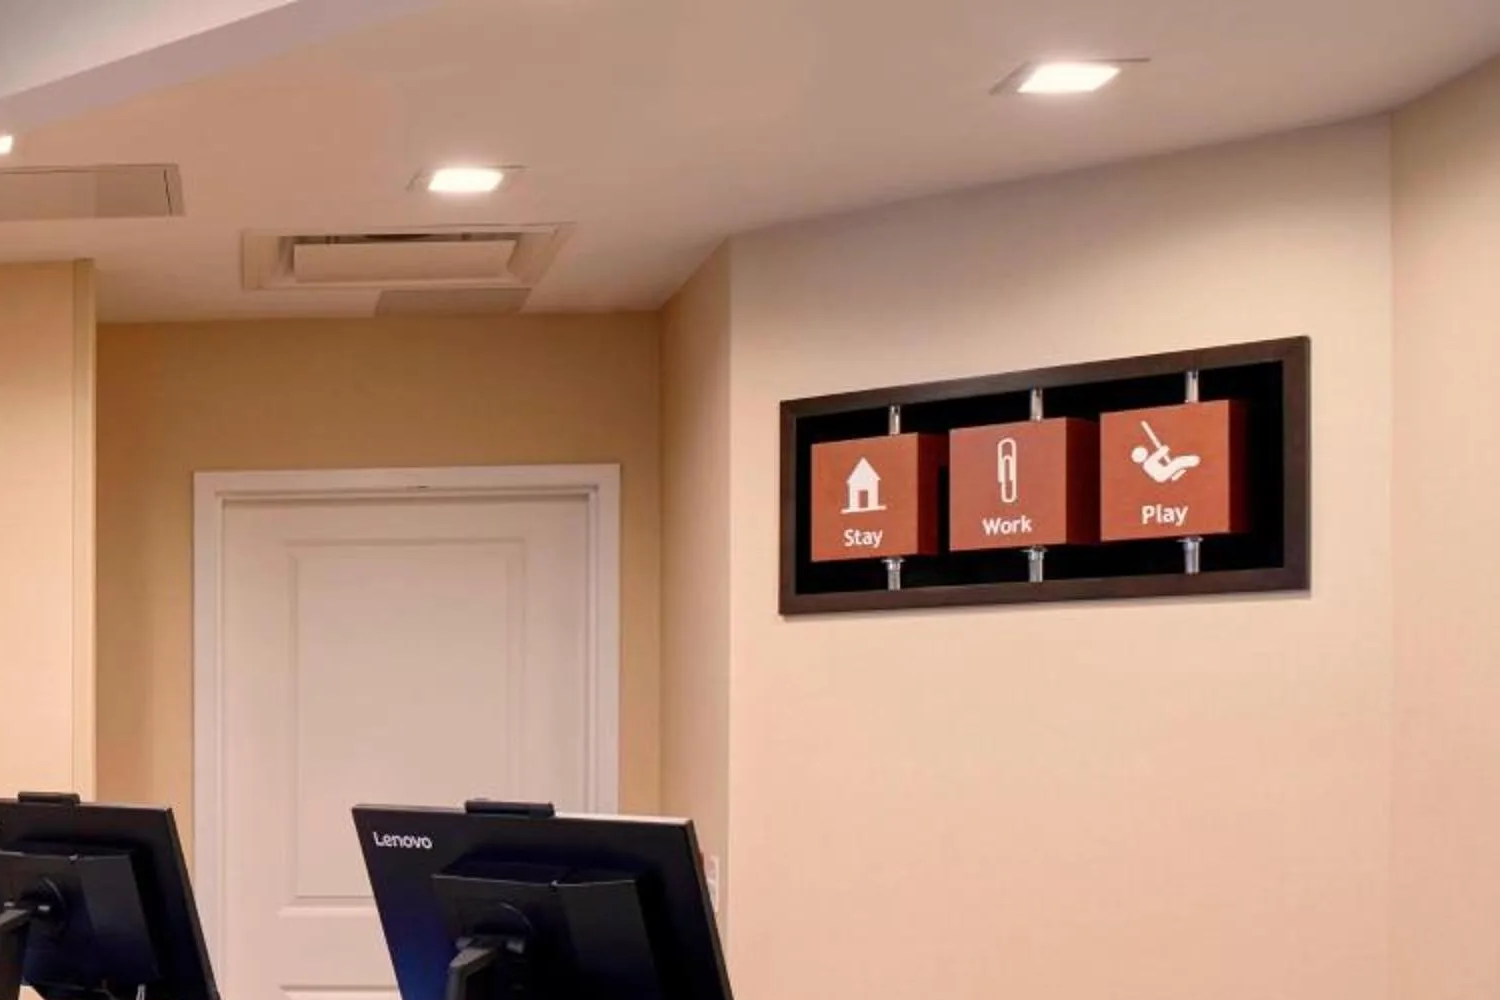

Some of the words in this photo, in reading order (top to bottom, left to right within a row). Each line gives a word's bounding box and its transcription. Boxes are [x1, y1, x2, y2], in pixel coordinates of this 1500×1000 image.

[982, 515, 1033, 536] Work
[1140, 504, 1190, 527] Play
[843, 527, 884, 549] Stay
[373, 831, 433, 849] Lenovo
